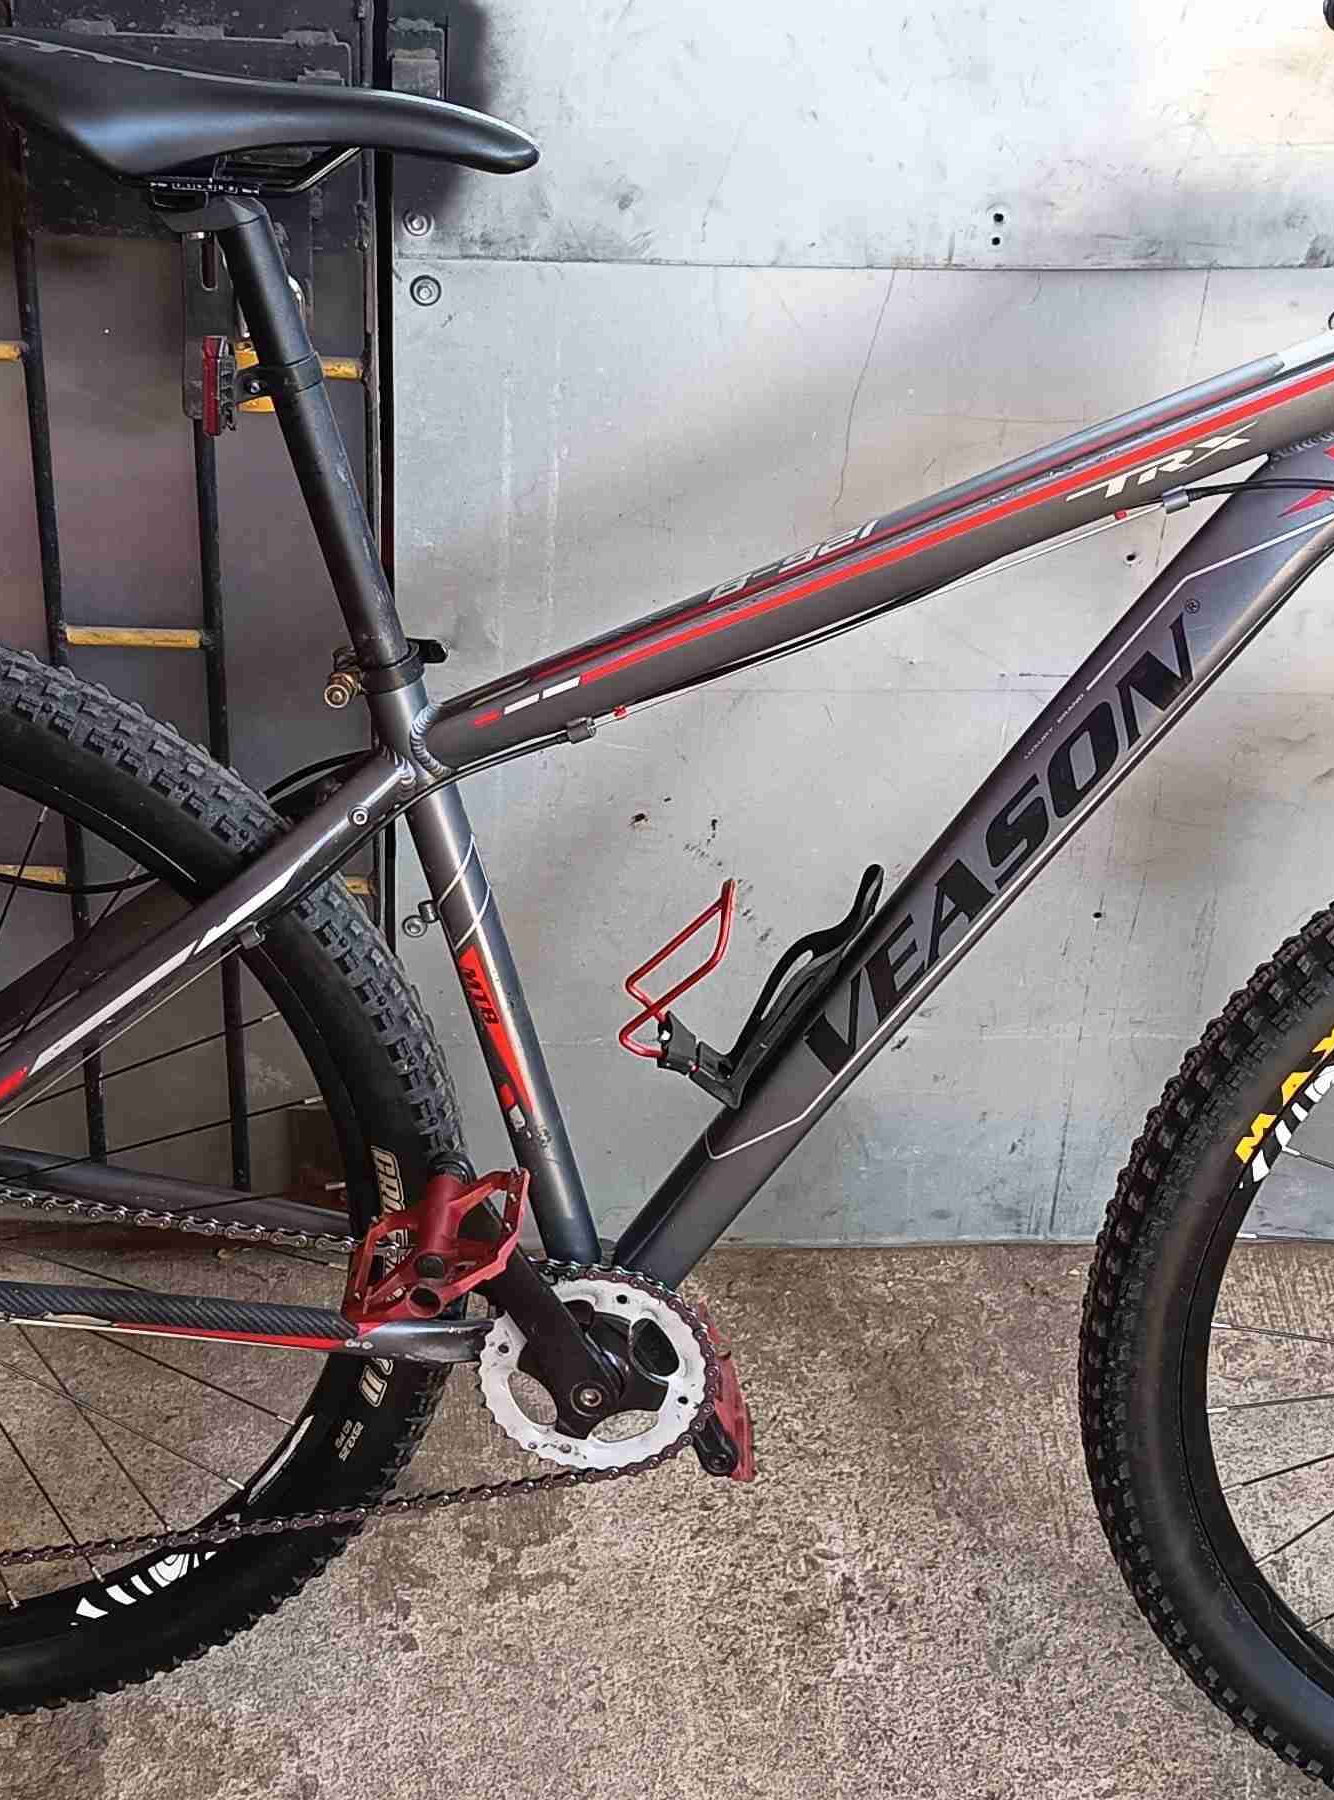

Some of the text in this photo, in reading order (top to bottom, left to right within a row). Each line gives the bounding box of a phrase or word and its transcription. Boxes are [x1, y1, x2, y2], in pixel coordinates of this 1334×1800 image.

[1065, 420, 1258, 502] TRX
[803, 612, 1195, 1076] VEASON
[464, 966, 501, 1026] MTB
